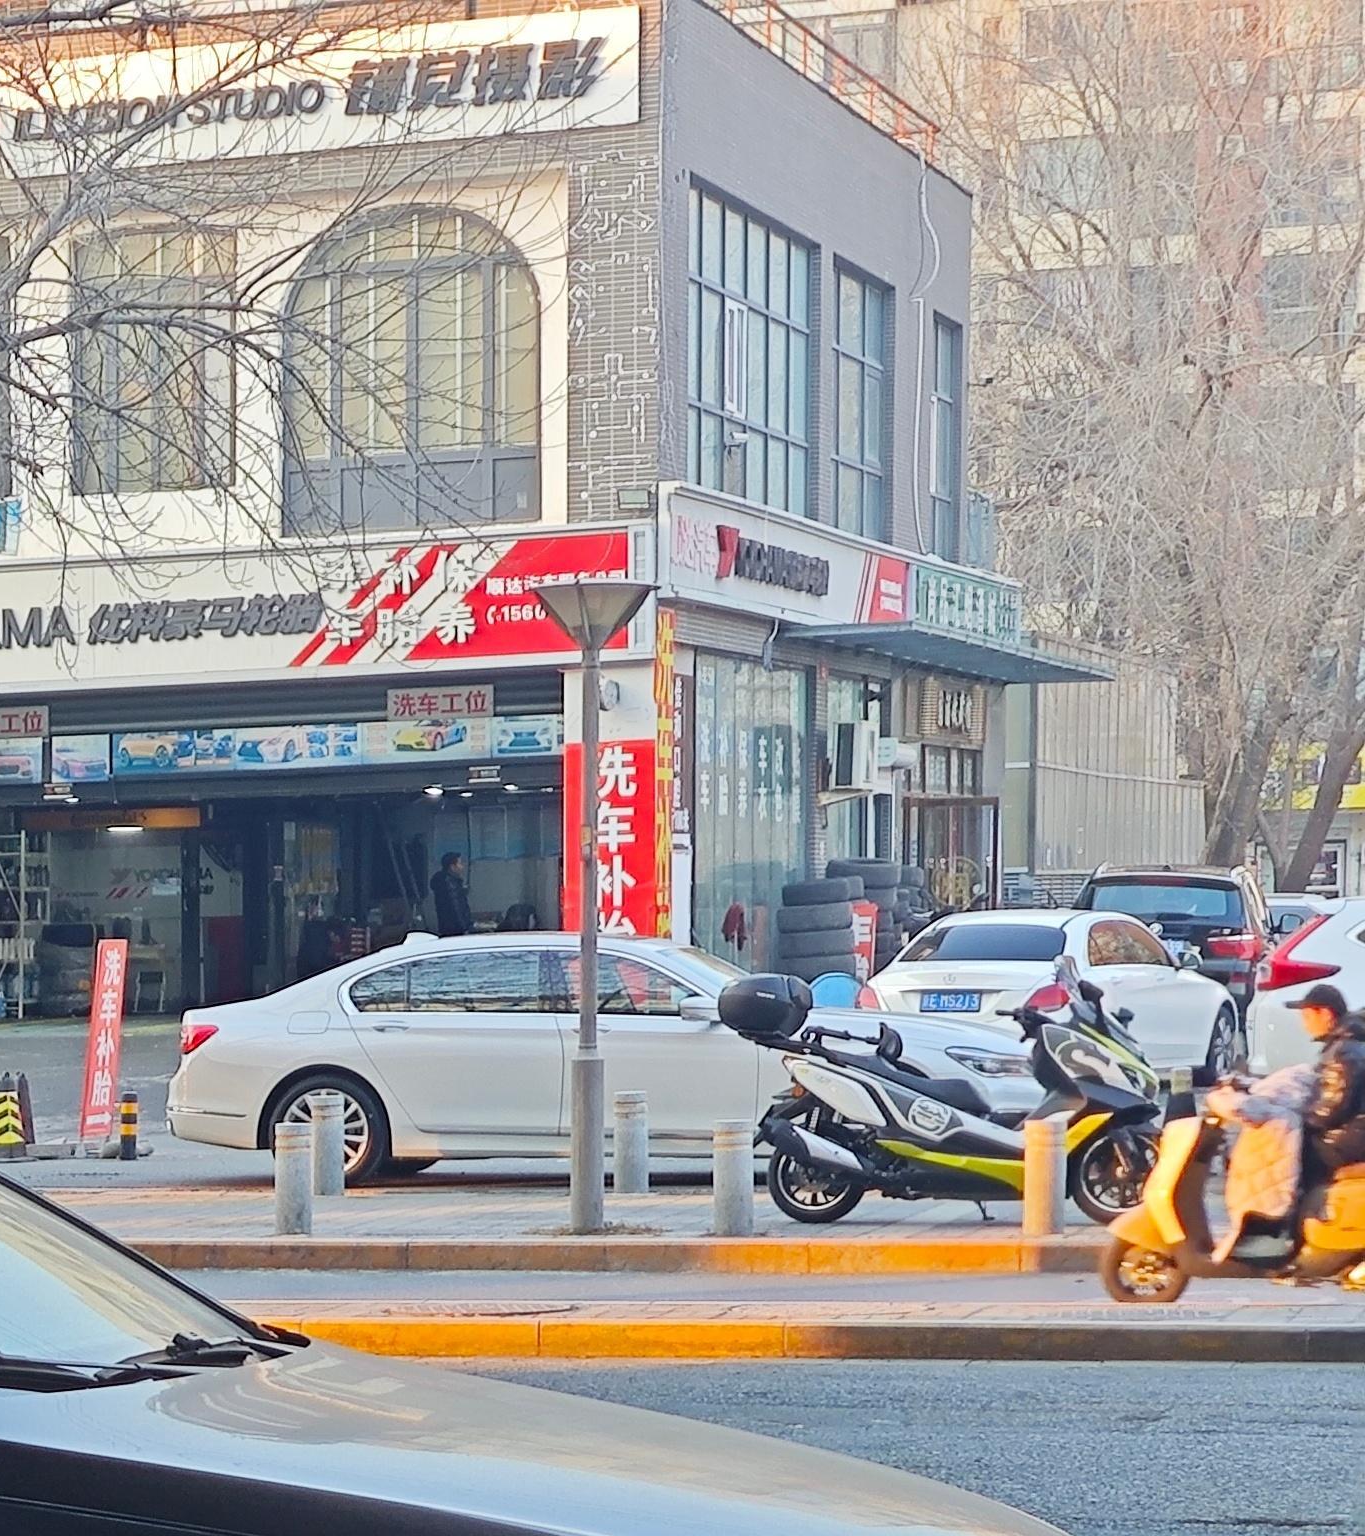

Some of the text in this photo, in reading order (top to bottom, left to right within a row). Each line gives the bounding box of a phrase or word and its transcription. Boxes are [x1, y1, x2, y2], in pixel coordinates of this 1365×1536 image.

[187, 79, 325, 125] STUDIO
[345, 36, 603, 116] 错觉摄影
[88, 593, 321, 645] 优科豪马轮胎
[392, 690, 488, 718] 洗车工位
[90, 946, 122, 1107] 洗车补胎
